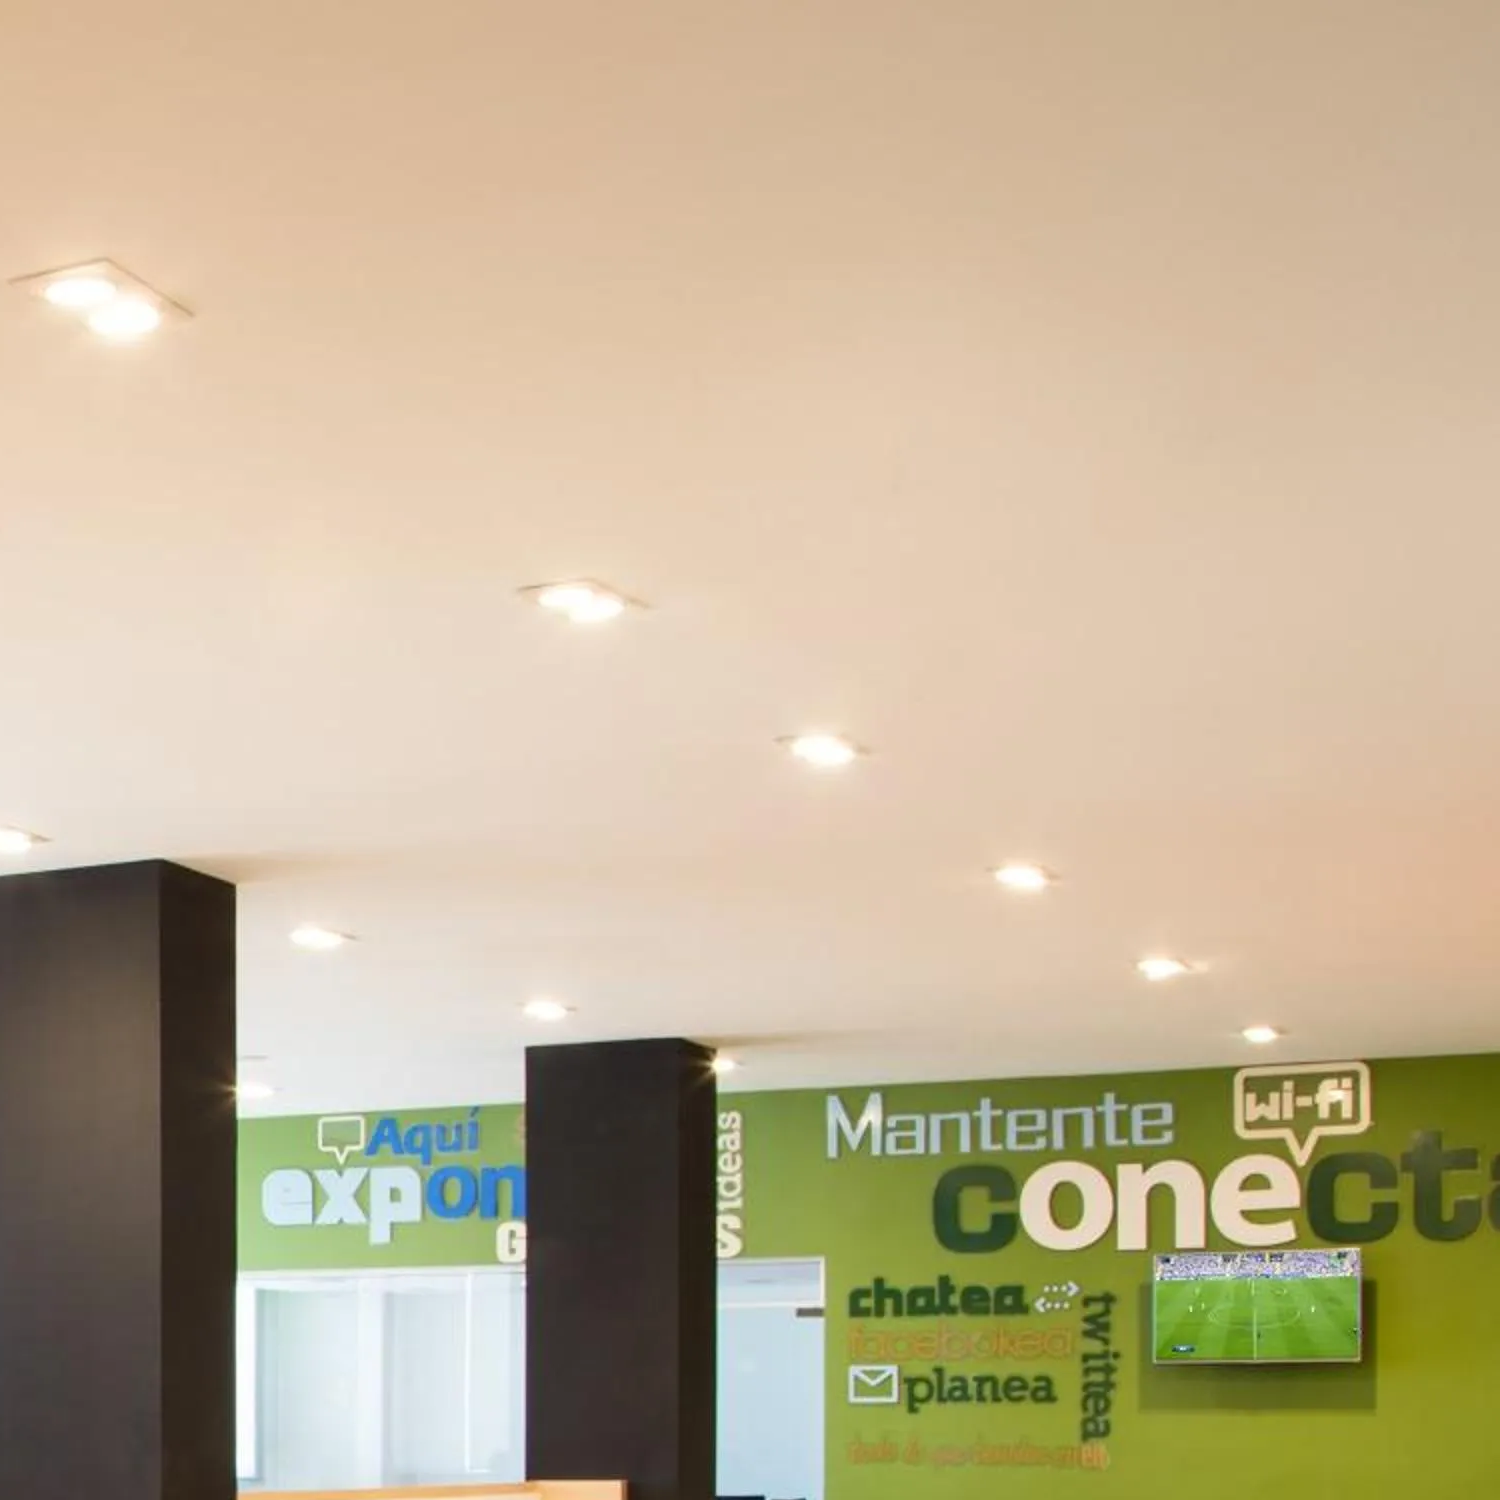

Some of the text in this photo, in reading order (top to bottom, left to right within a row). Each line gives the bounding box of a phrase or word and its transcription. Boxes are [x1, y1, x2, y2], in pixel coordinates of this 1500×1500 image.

[826, 1092, 1174, 1159] Mantente
[1244, 1077, 1353, 1123] wi-fi
[364, 1106, 481, 1167] Aquí
[932, 1130, 1500, 1254] conect
[848, 1275, 1029, 1318] chatea
[904, 1366, 1058, 1414] planea
[1080, 1292, 1121, 1442] twittea
